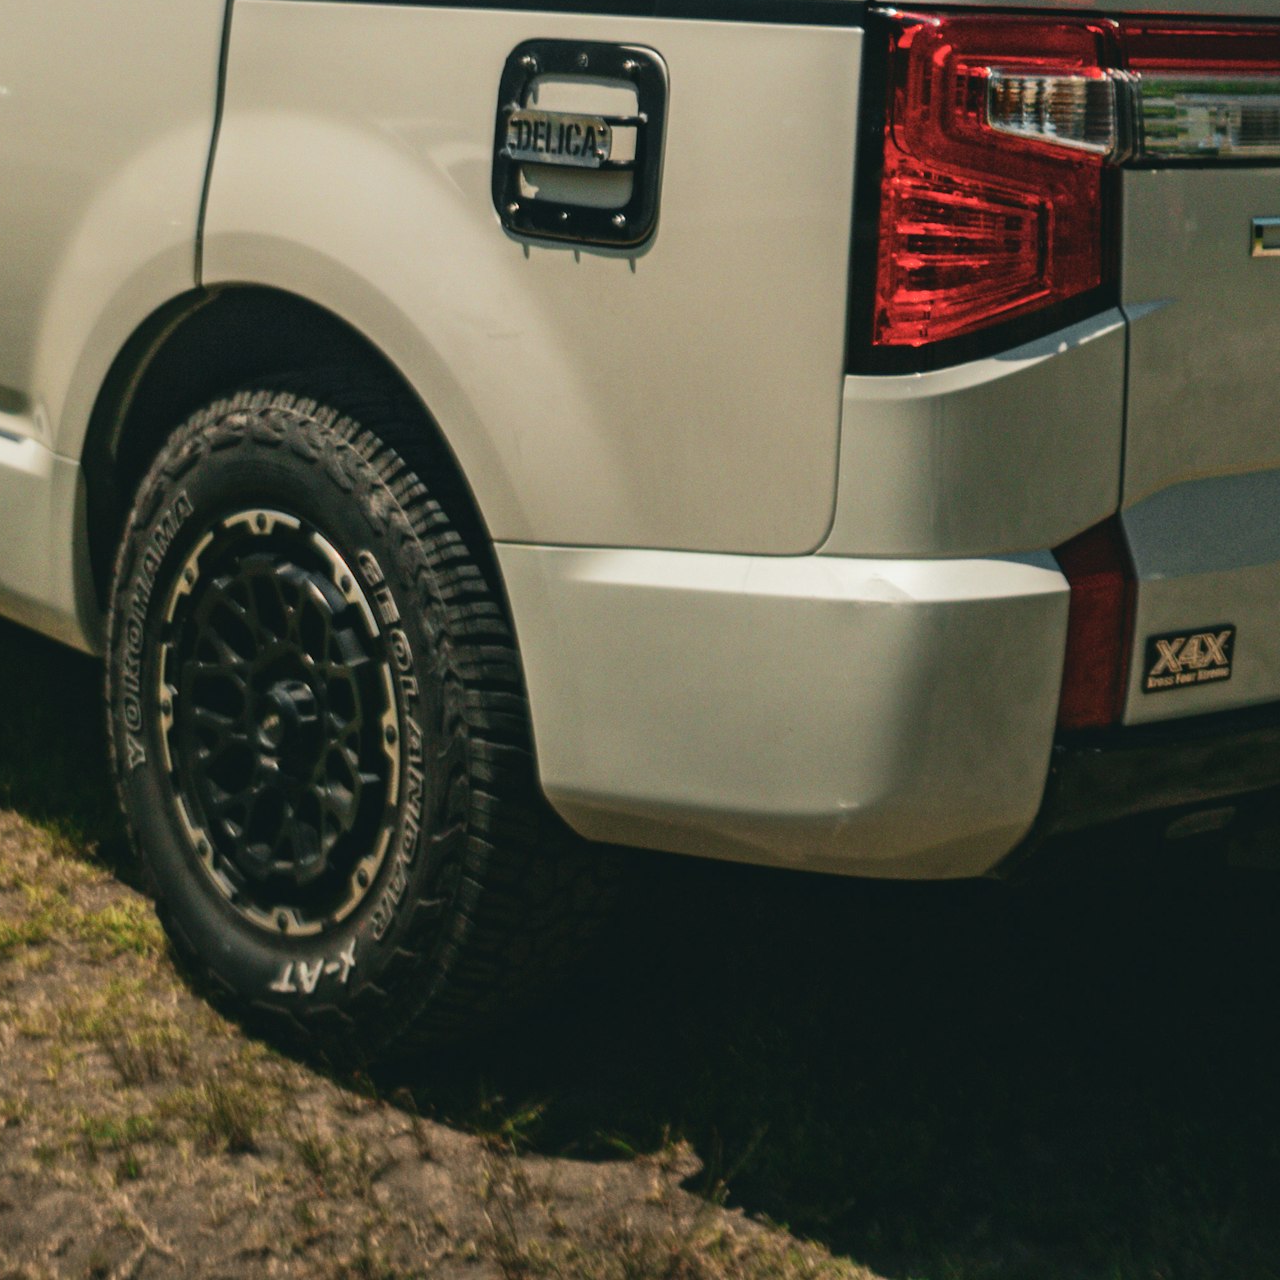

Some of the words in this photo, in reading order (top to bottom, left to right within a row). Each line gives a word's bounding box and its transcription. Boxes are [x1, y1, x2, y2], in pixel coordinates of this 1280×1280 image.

[516, 118, 599, 158] DELICA
[122, 489, 195, 772] YOKOHAMA
[1150, 631, 1232, 674] X4X
[358, 547, 426, 944] GEOLANDAR
[269, 933, 360, 994] X-AT
